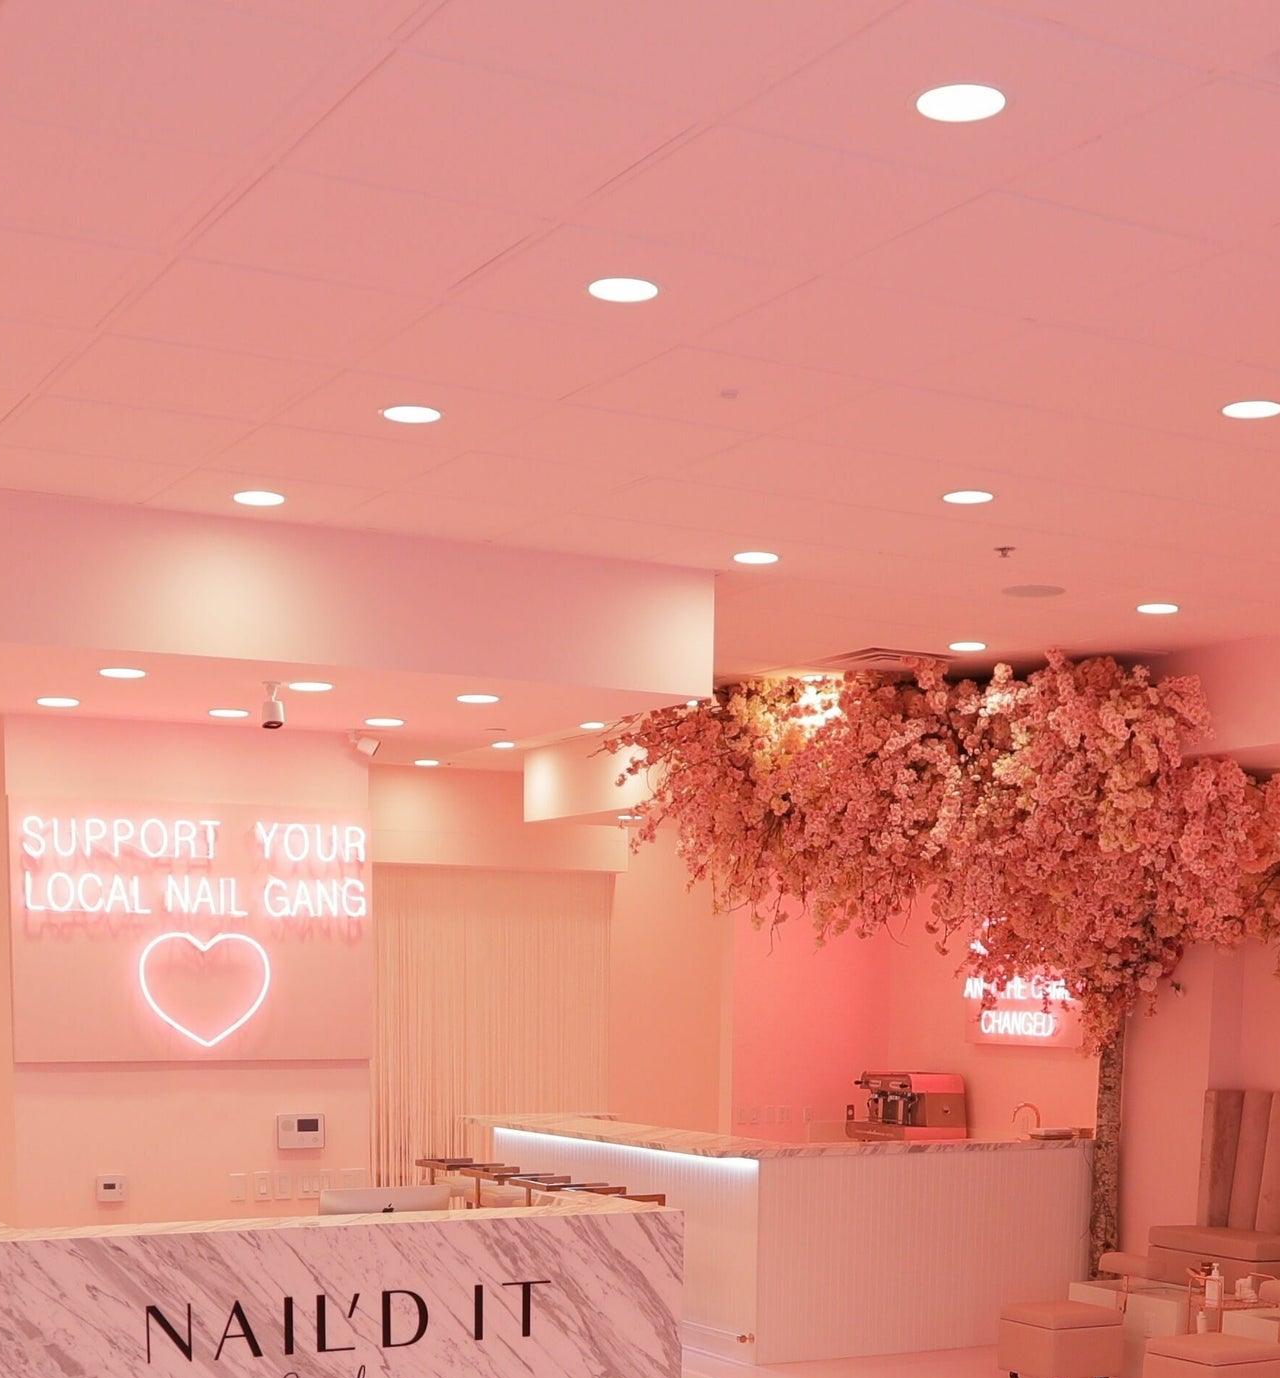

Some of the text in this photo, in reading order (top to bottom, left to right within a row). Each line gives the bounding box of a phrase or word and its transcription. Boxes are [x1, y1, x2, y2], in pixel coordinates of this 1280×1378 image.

[21, 815, 367, 863] SUPPORT YOUR
[23, 871, 367, 918] LOCAL NAIL GANG
[963, 976, 994, 999] AN
[981, 1009, 1056, 1037] CHANGED
[145, 1279, 552, 1365] NAIL'D IT
